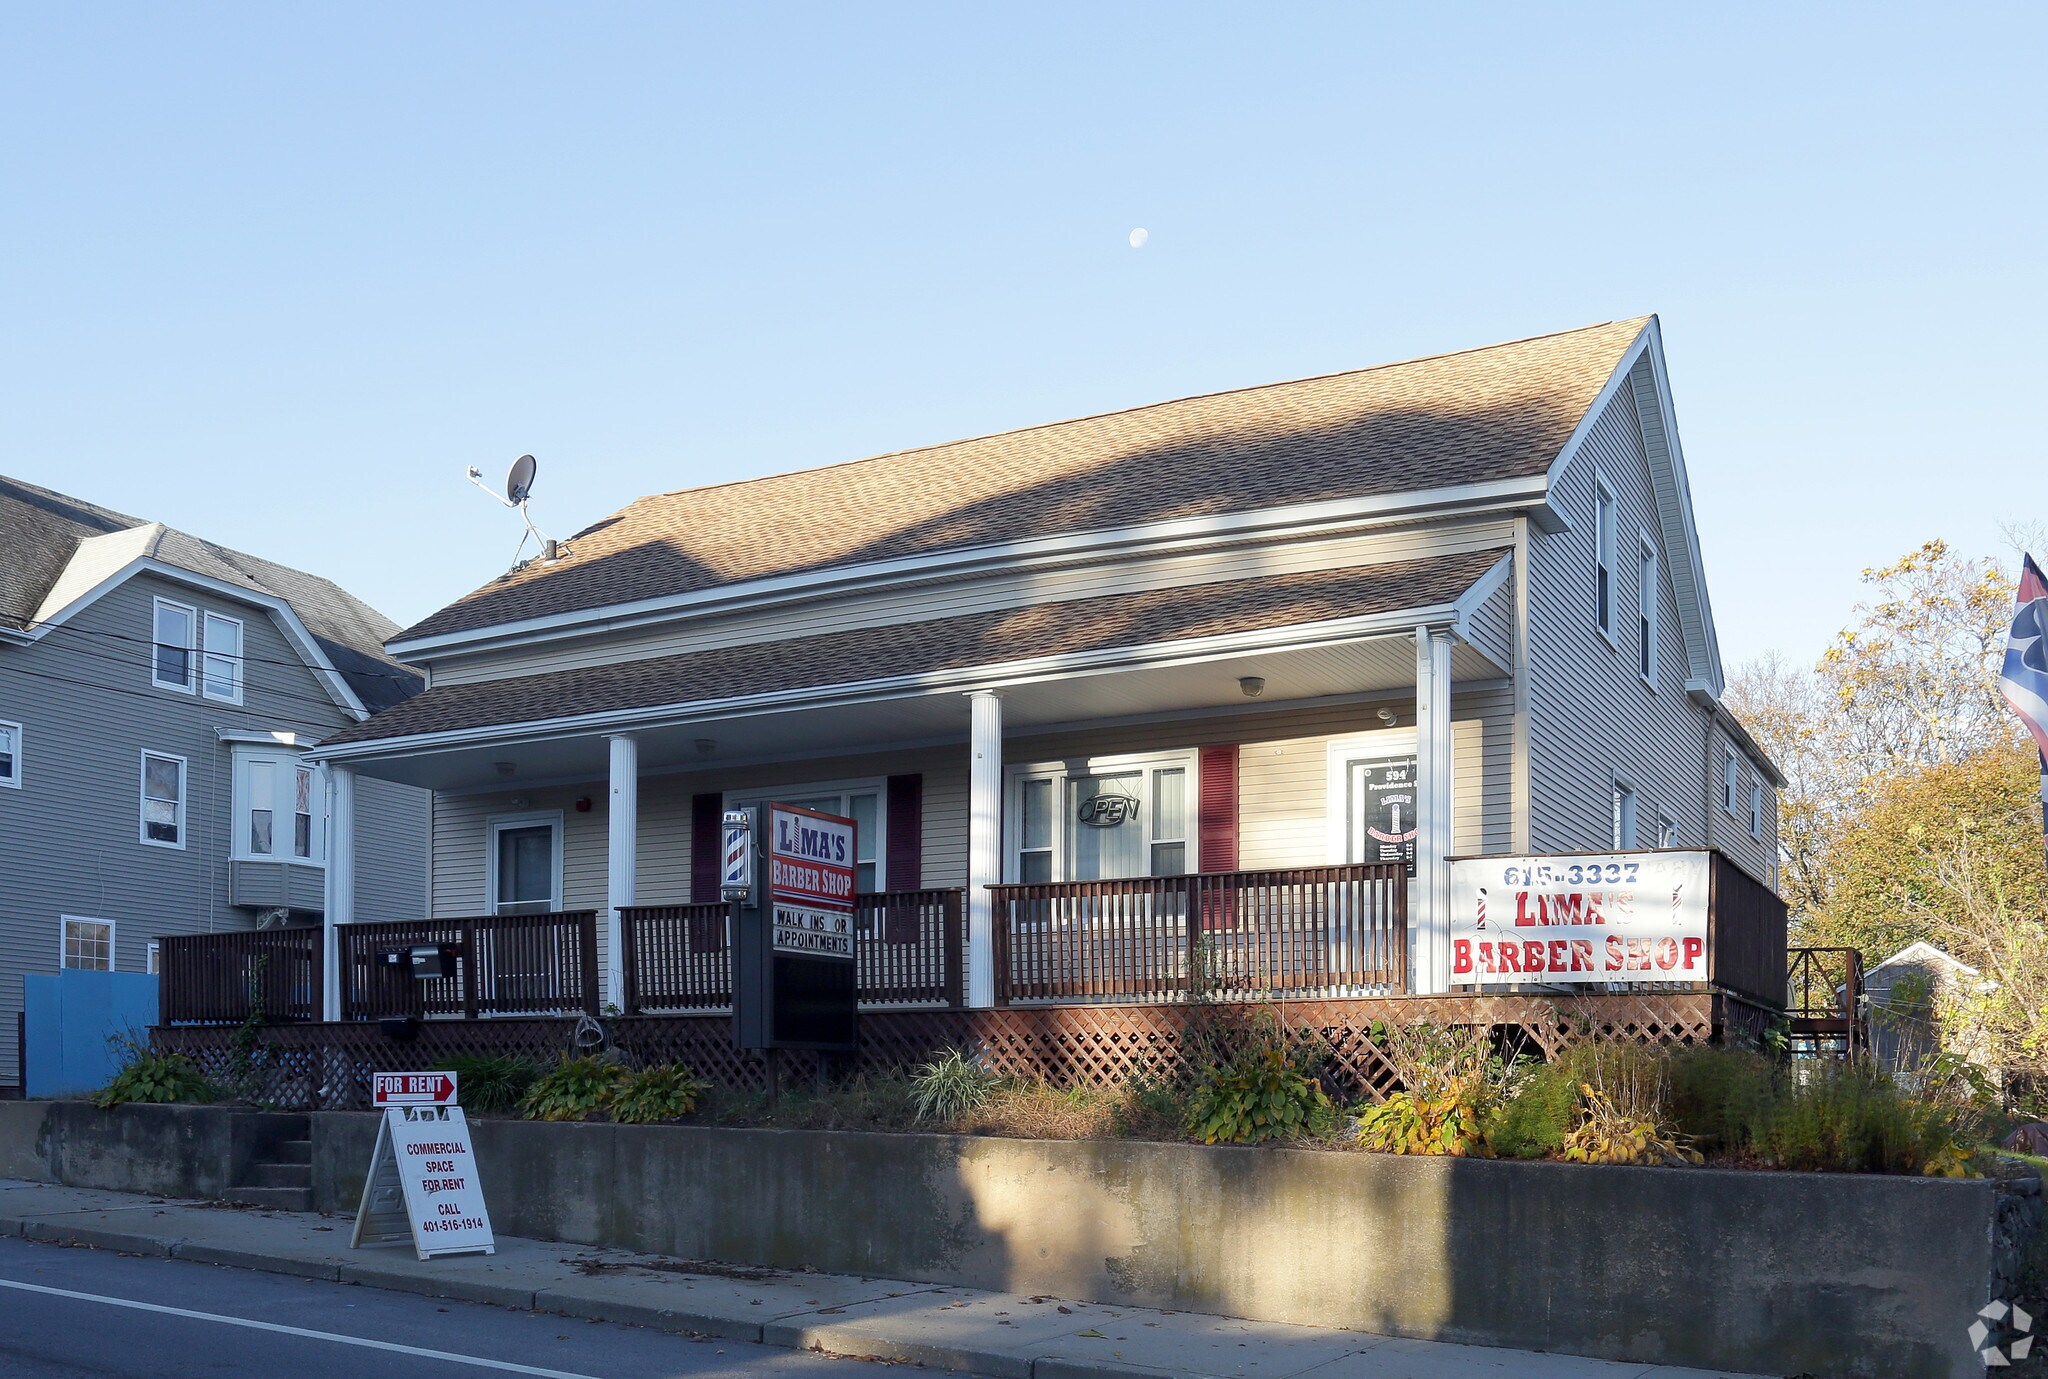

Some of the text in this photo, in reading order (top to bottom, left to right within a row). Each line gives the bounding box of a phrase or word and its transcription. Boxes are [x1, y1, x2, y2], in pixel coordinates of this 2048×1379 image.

[1385, 769, 1407, 781] 594
[1368, 781, 1413, 791] Providence
[1078, 797, 1141, 821] OPEN
[779, 816, 845, 862] LIMA'S
[773, 859, 852, 897] BARBER SHOP
[1503, 863, 1640, 887] 615-3337
[1514, 891, 1635, 927] LIMA'S
[776, 909, 847, 933] WALK INS OR
[777, 930, 848, 952] APPOINTMENTS
[1453, 934, 1706, 973] BARBER SHOP
[377, 1076, 444, 1093] FOR RENT
[406, 1142, 466, 1155] COMMERCIAL
[425, 1160, 455, 1173] SPACE
[422, 1178, 465, 1191] FOR RENT
[437, 1203, 461, 1216] CALL
[423, 1217, 483, 1232] 401-516-1914
